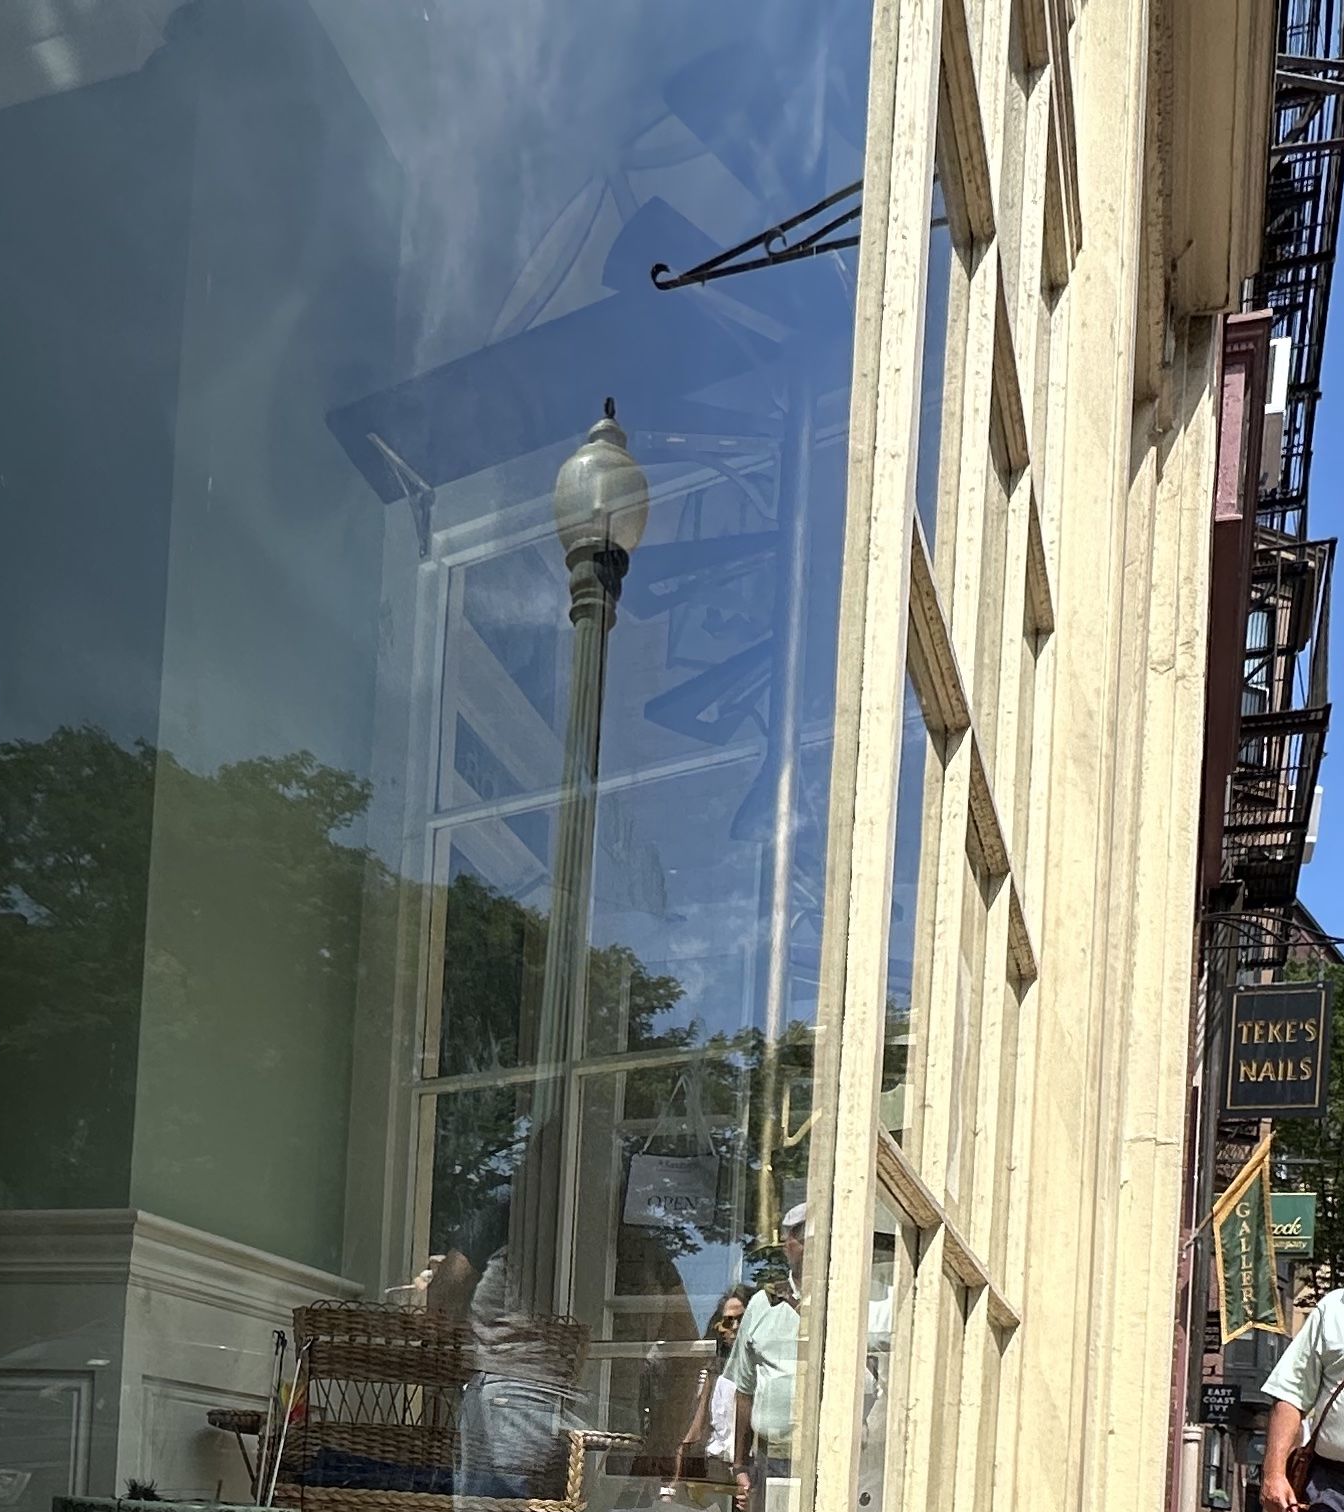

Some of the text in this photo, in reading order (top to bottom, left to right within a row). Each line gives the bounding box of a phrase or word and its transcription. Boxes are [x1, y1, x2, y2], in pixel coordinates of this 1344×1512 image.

[1237, 1018, 1317, 1044] TEKE'S
[1239, 1057, 1312, 1082] NAILS
[647, 1195, 696, 1211] OPEN
[1207, 1388, 1232, 1396] EAST
[1203, 1396, 1236, 1405] COAST
